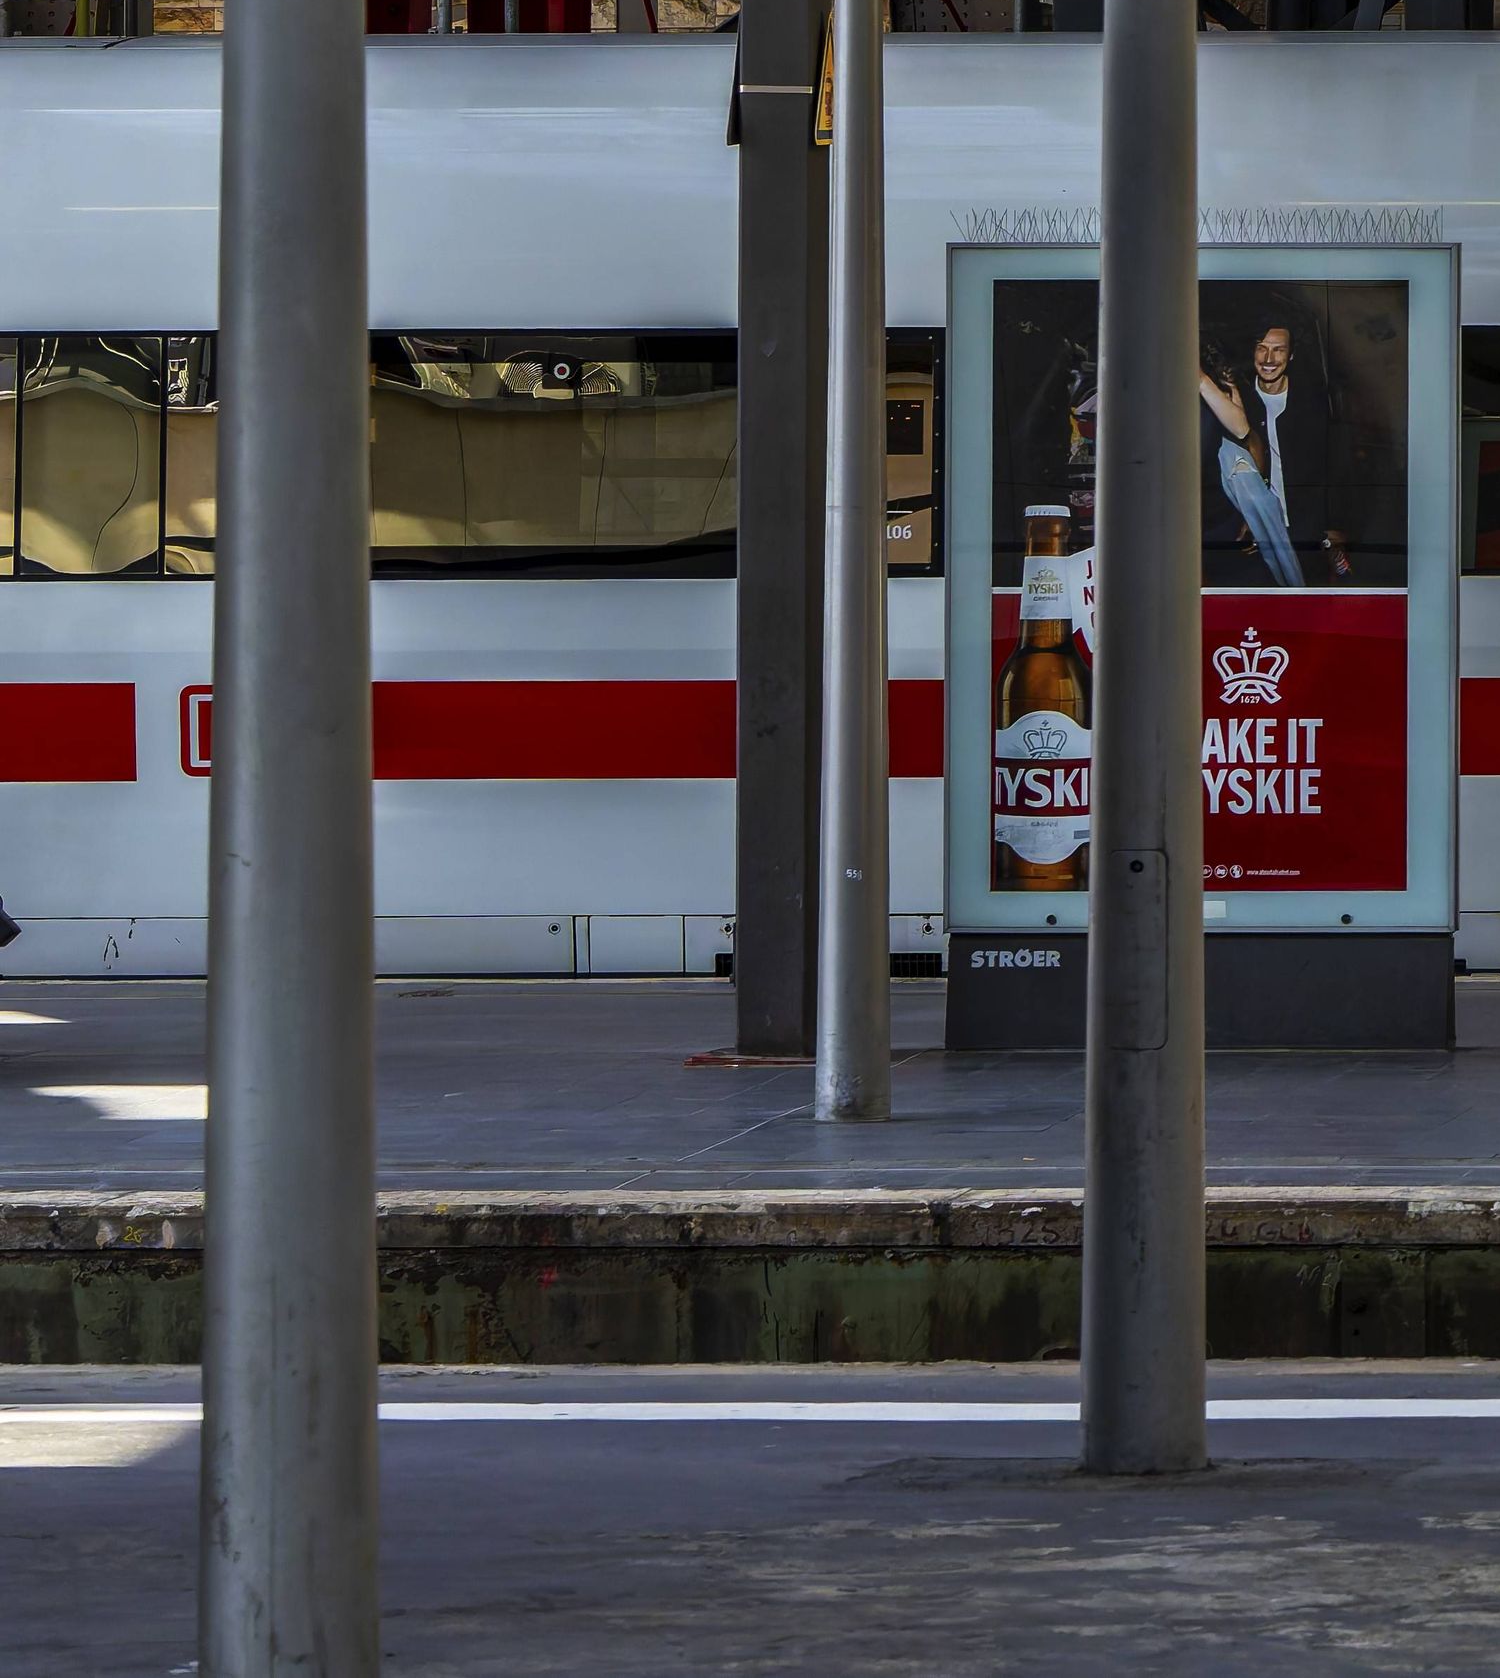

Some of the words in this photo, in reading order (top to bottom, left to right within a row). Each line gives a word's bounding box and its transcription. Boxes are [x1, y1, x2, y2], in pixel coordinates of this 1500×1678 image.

[1240, 695, 1261, 705] 1629
[1201, 718, 1278, 764] AKE
[1287, 718, 1324, 764] IT
[1201, 768, 1322, 815] YSKIE
[971, 948, 1061, 968] STRÖER
